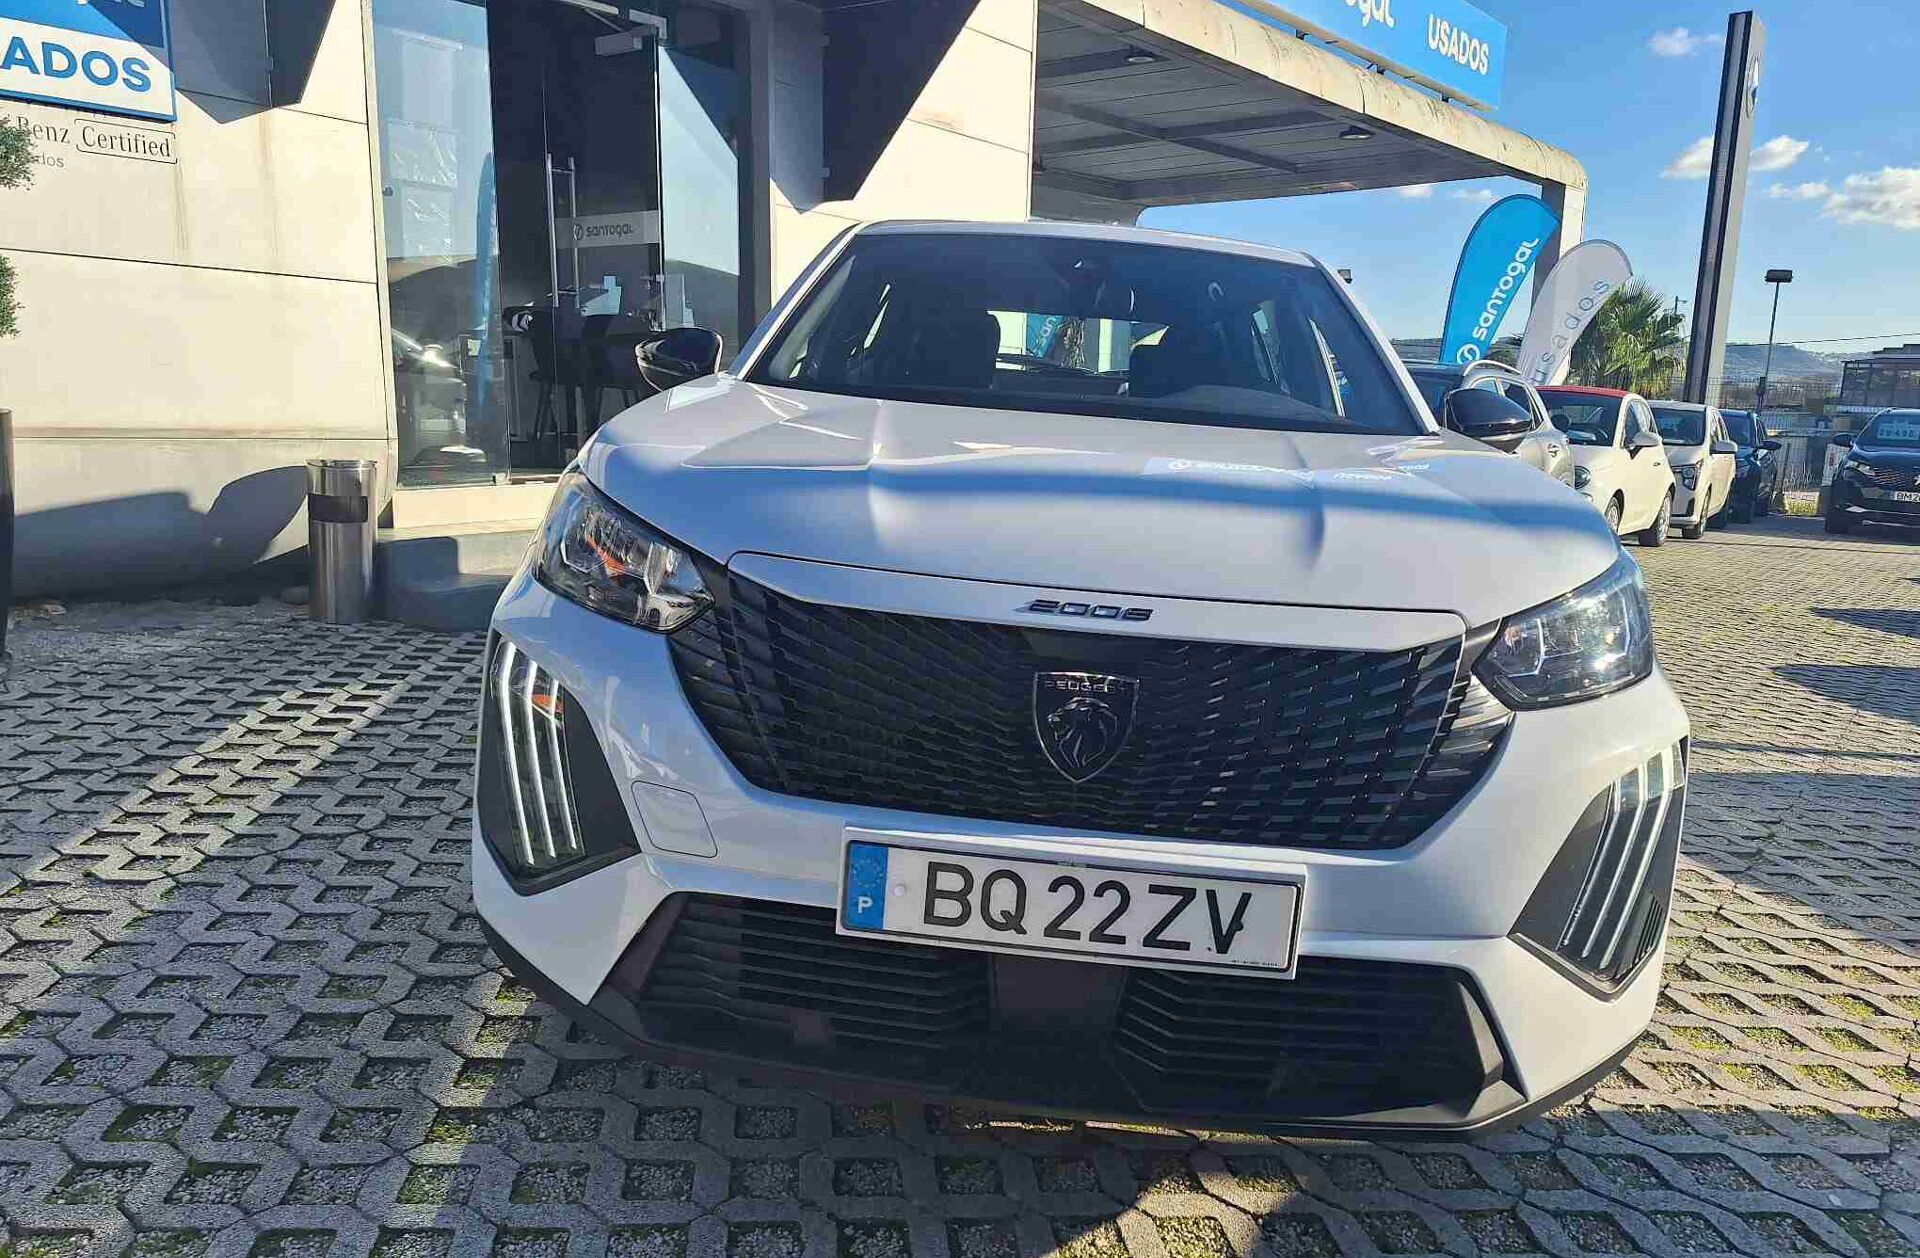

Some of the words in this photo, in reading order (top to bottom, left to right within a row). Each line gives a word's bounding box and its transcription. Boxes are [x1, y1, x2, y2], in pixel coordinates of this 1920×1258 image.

[1427, 13, 1490, 75] USADOS
[81, 125, 171, 158] Certified
[1472, 237, 1541, 342] santogal
[1535, 280, 1610, 383] usados
[1029, 599, 1154, 621] 2008
[857, 897, 873, 914] P
